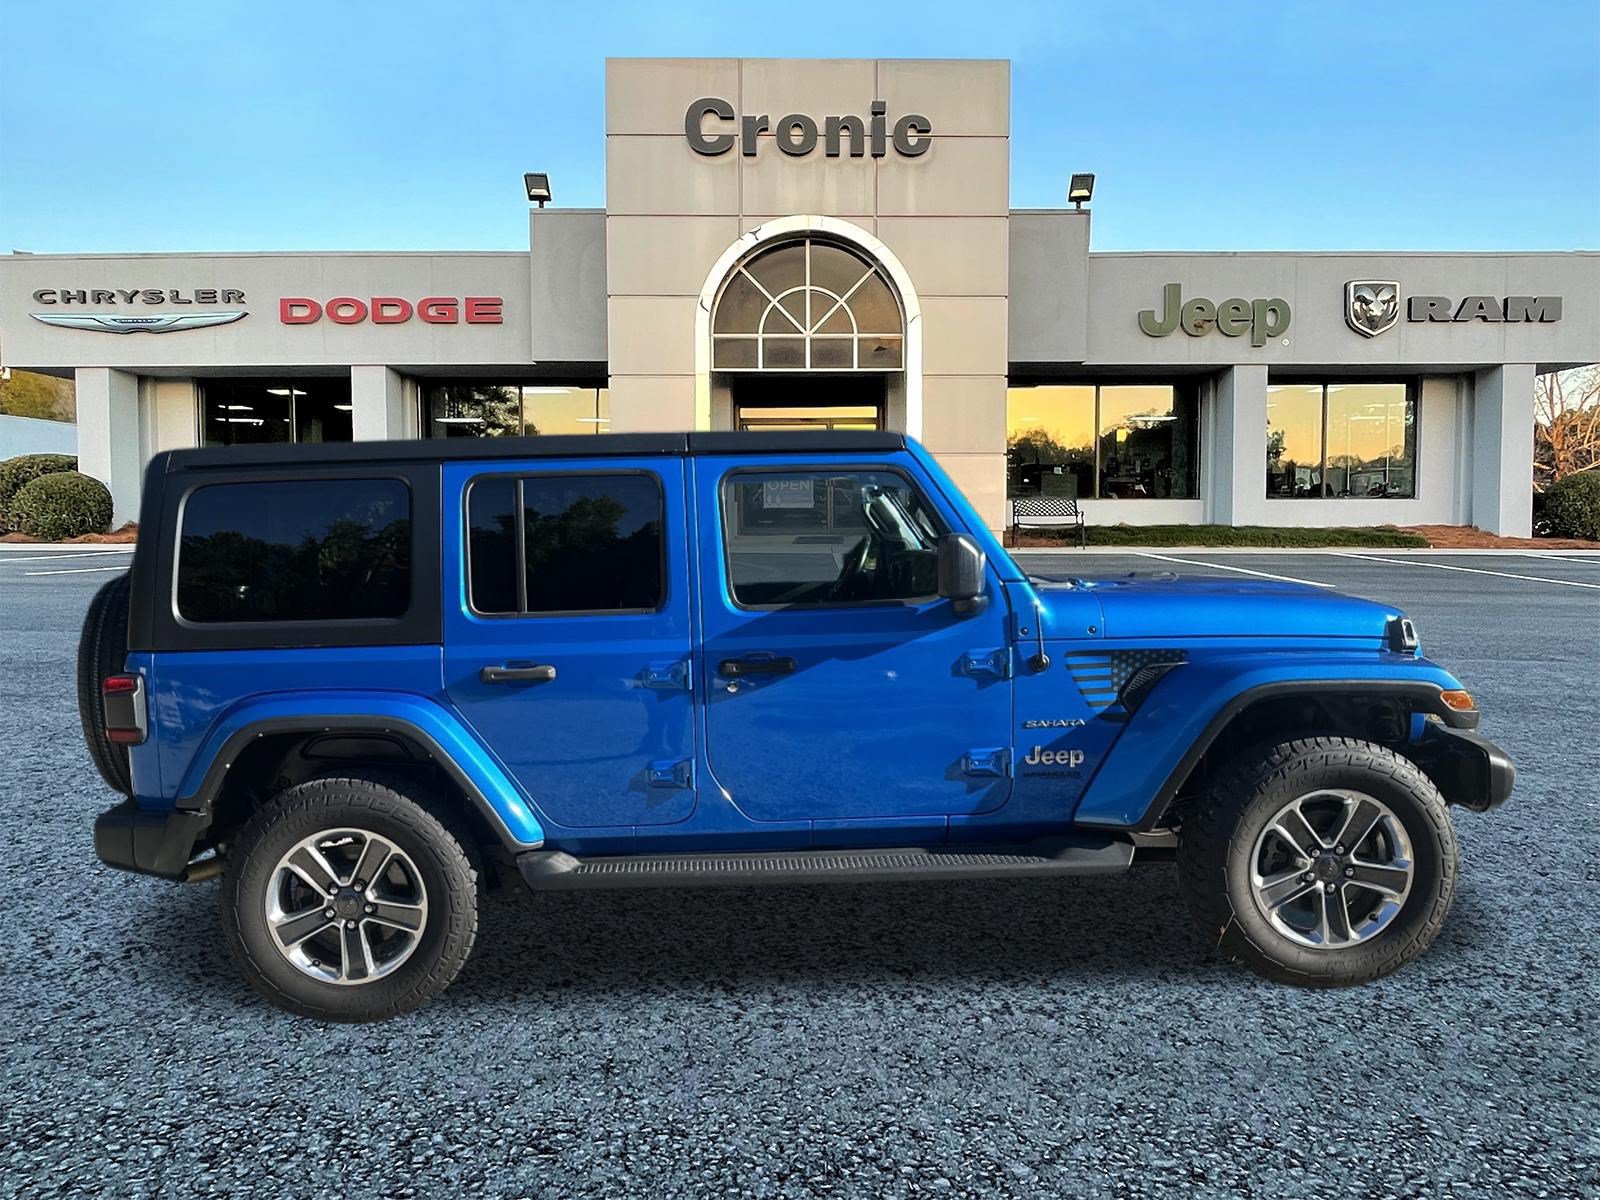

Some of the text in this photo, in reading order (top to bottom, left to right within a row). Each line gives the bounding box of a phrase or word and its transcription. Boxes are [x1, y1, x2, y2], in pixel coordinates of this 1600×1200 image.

[685, 97, 932, 157] Cronic
[31, 288, 246, 305] CHRYSLER
[279, 296, 504, 325] DODGE
[1138, 282, 1291, 347] Jeep
[1407, 296, 1562, 323] RAM
[767, 480, 810, 491] OPEN
[1024, 718, 1086, 728] SAHARA
[1025, 745, 1085, 768] Jeep
